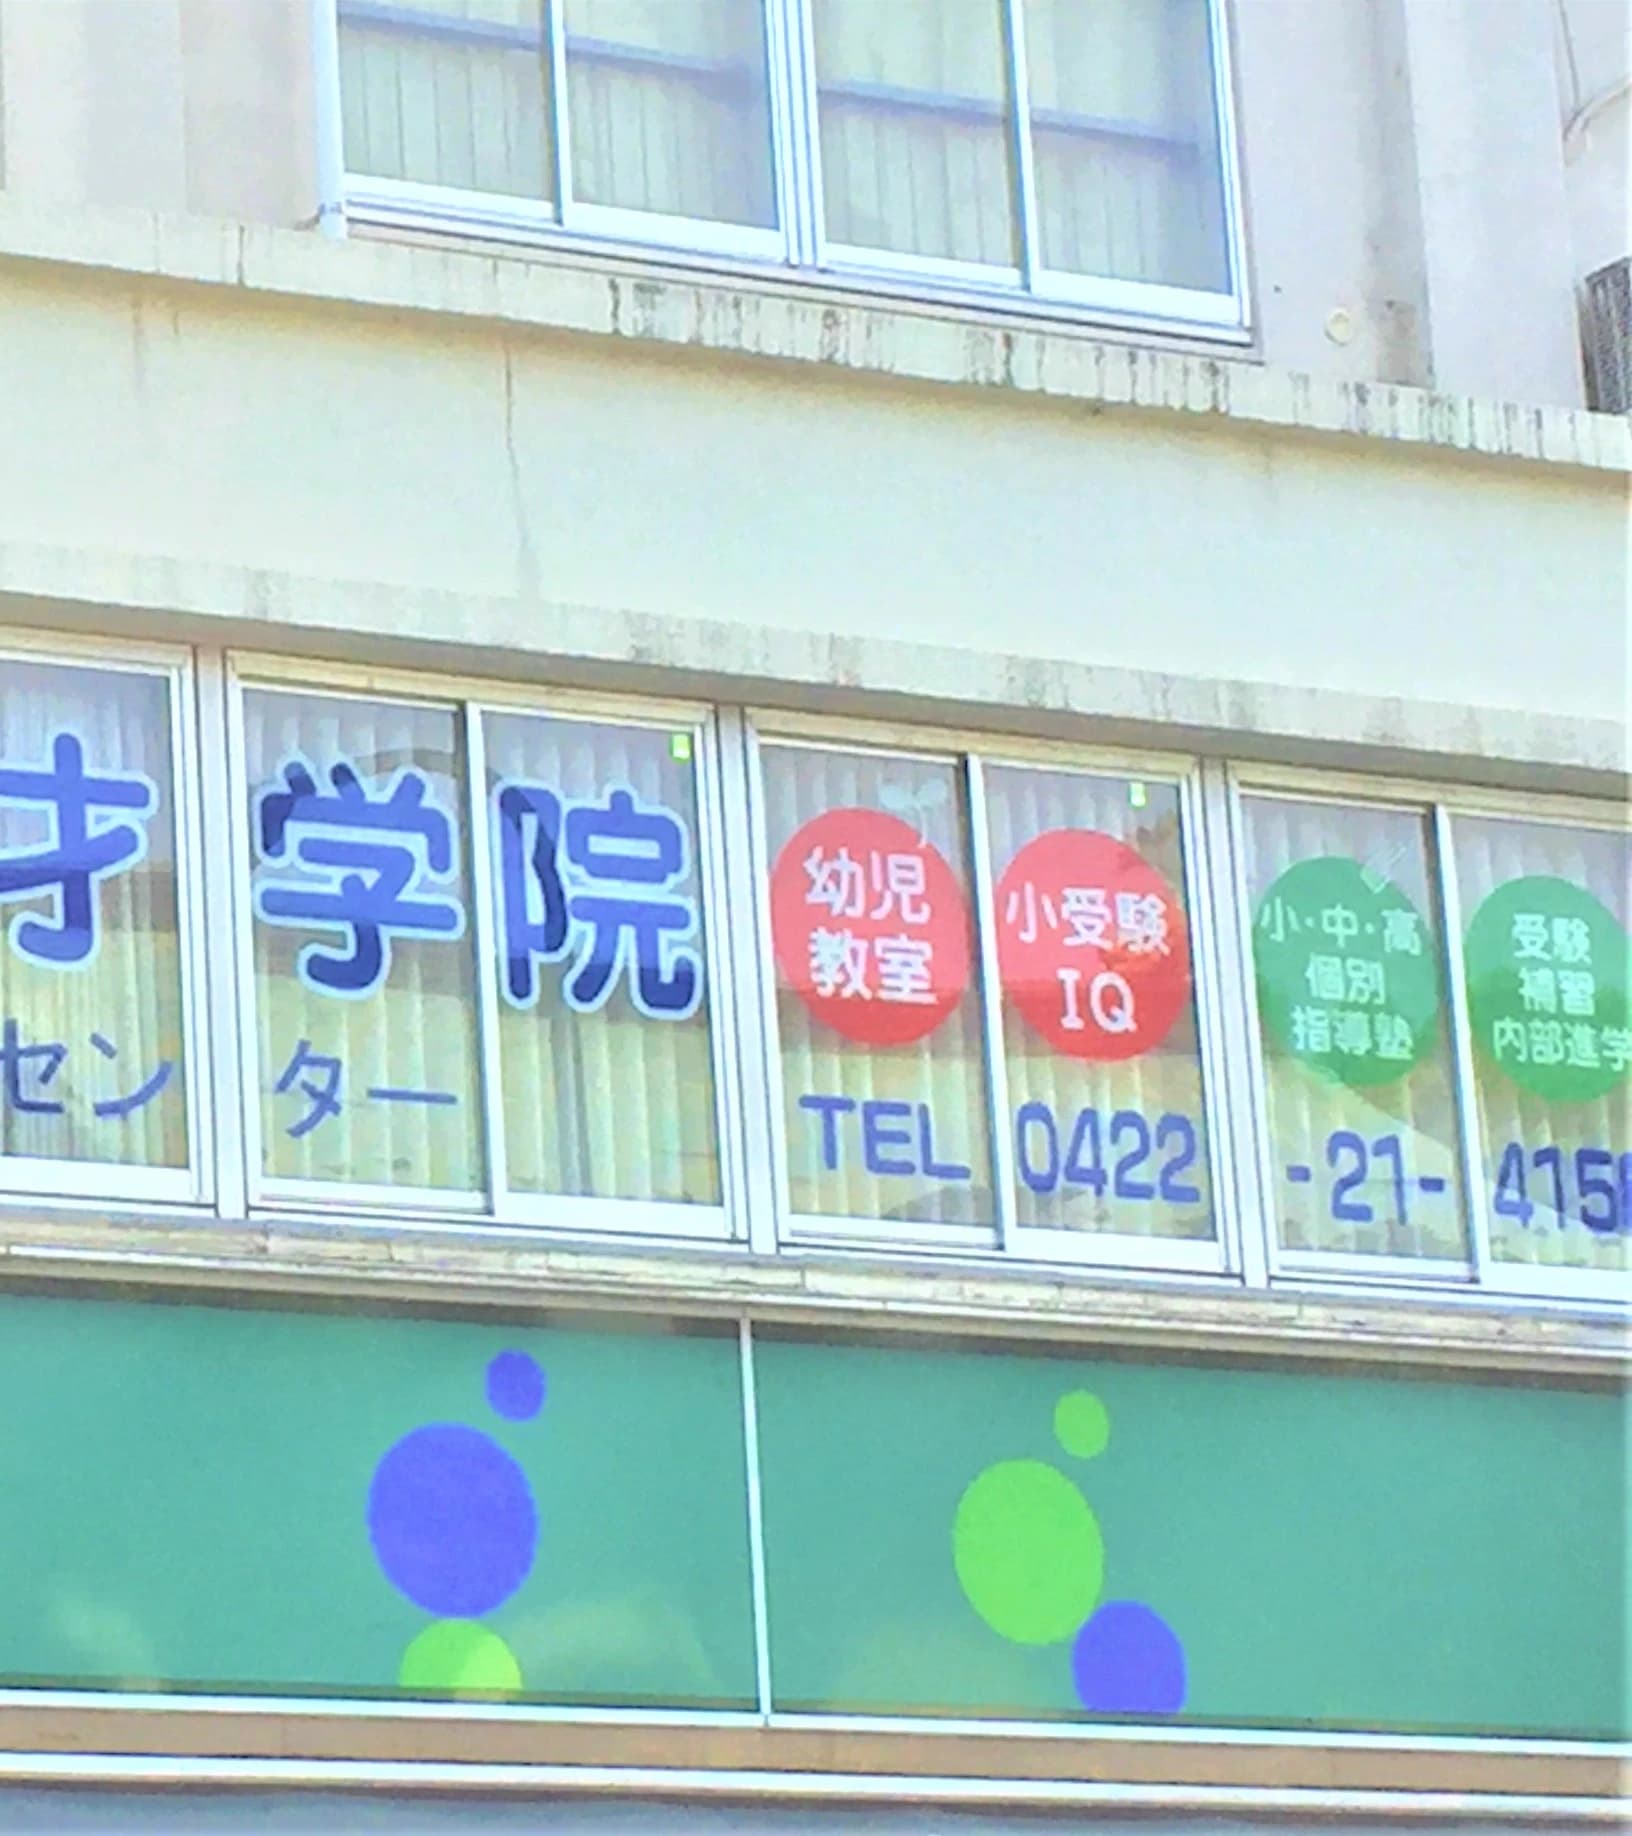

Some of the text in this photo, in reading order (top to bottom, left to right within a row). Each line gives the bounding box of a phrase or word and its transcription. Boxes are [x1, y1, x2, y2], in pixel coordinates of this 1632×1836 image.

[802, 845, 931, 924] 幼児
[1006, 881, 1172, 956] 小受験
[1511, 913, 1592, 965] 受験
[808, 926, 940, 1006] 教室
[1304, 954, 1386, 1005] 個別
[1517, 967, 1596, 1017] 補習
[1056, 967, 1138, 1034] IQ
[1290, 1004, 1414, 1061] 指導塾
[799, 1094, 972, 1180] TEL
